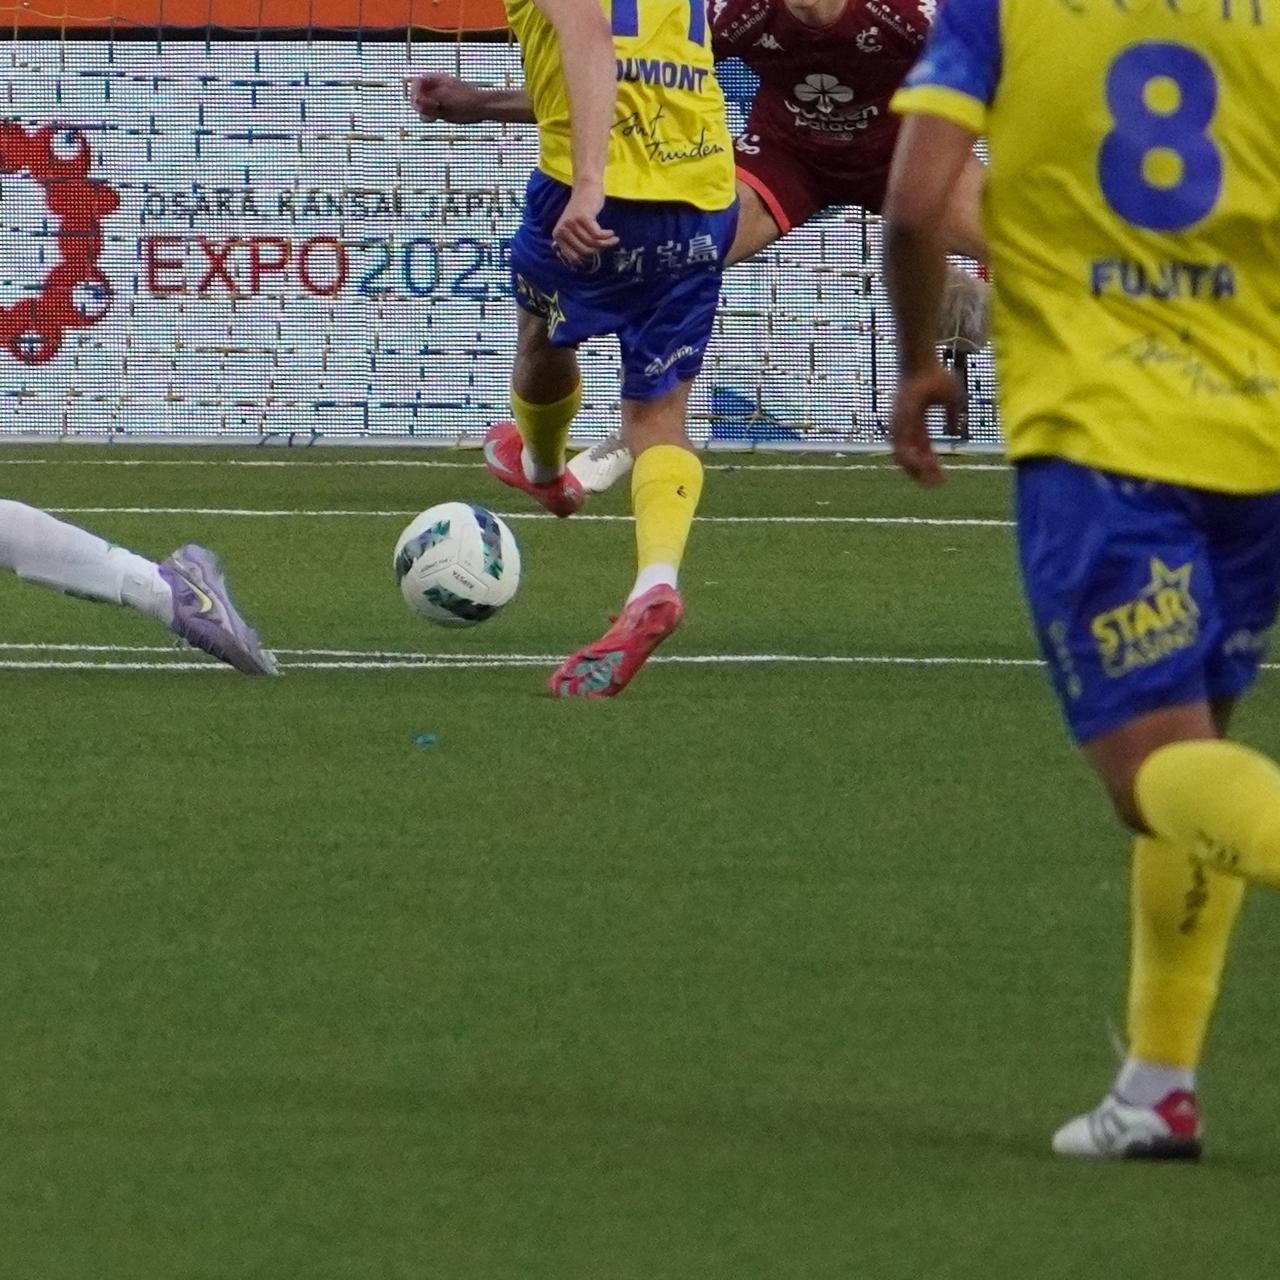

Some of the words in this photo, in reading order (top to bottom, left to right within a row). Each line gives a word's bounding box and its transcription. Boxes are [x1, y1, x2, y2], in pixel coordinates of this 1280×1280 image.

[1097, 40, 1224, 233] 8
[1090, 257, 1236, 299] FUJITA
[1091, 587, 1192, 657] STAR
